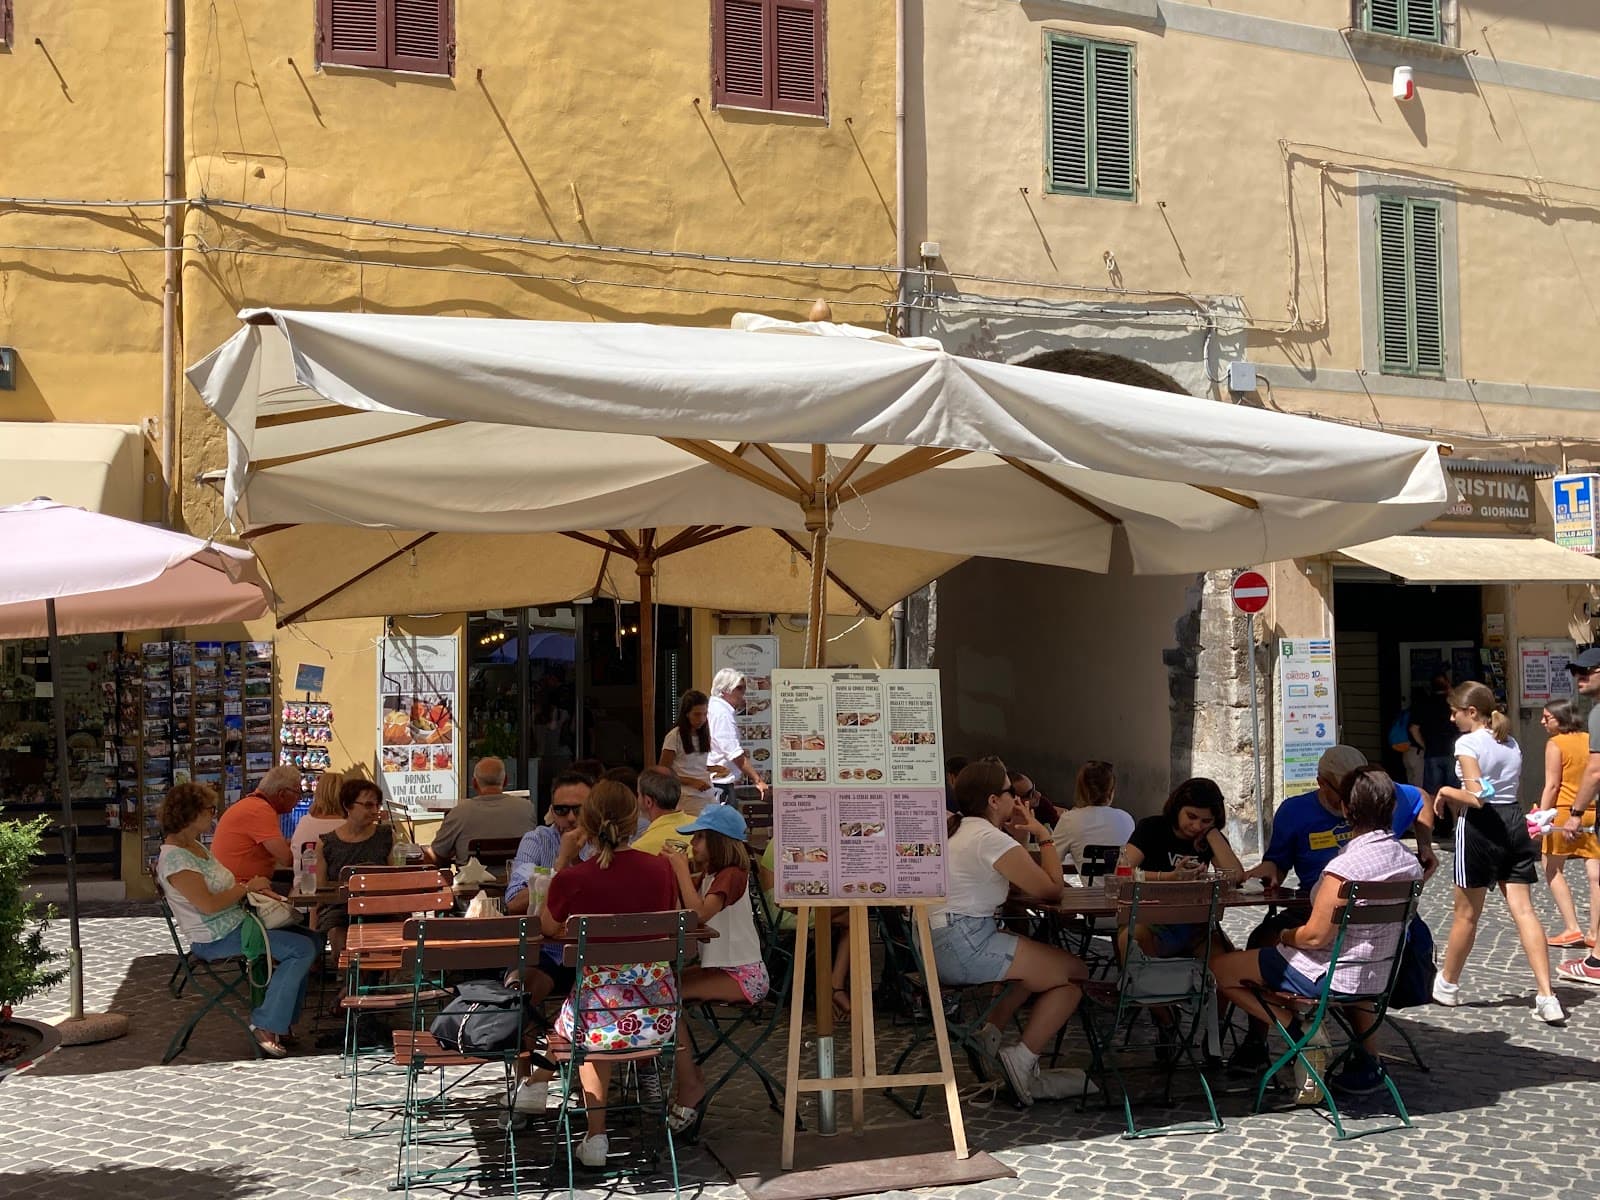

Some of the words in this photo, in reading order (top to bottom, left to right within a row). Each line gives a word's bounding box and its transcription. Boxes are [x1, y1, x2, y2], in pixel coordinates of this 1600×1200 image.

[1561, 482, 1584, 513] T
[1480, 506, 1530, 518] GIORNALI
[382, 672, 453, 693] APERITIVO
[404, 774, 431, 785] DRINKS
